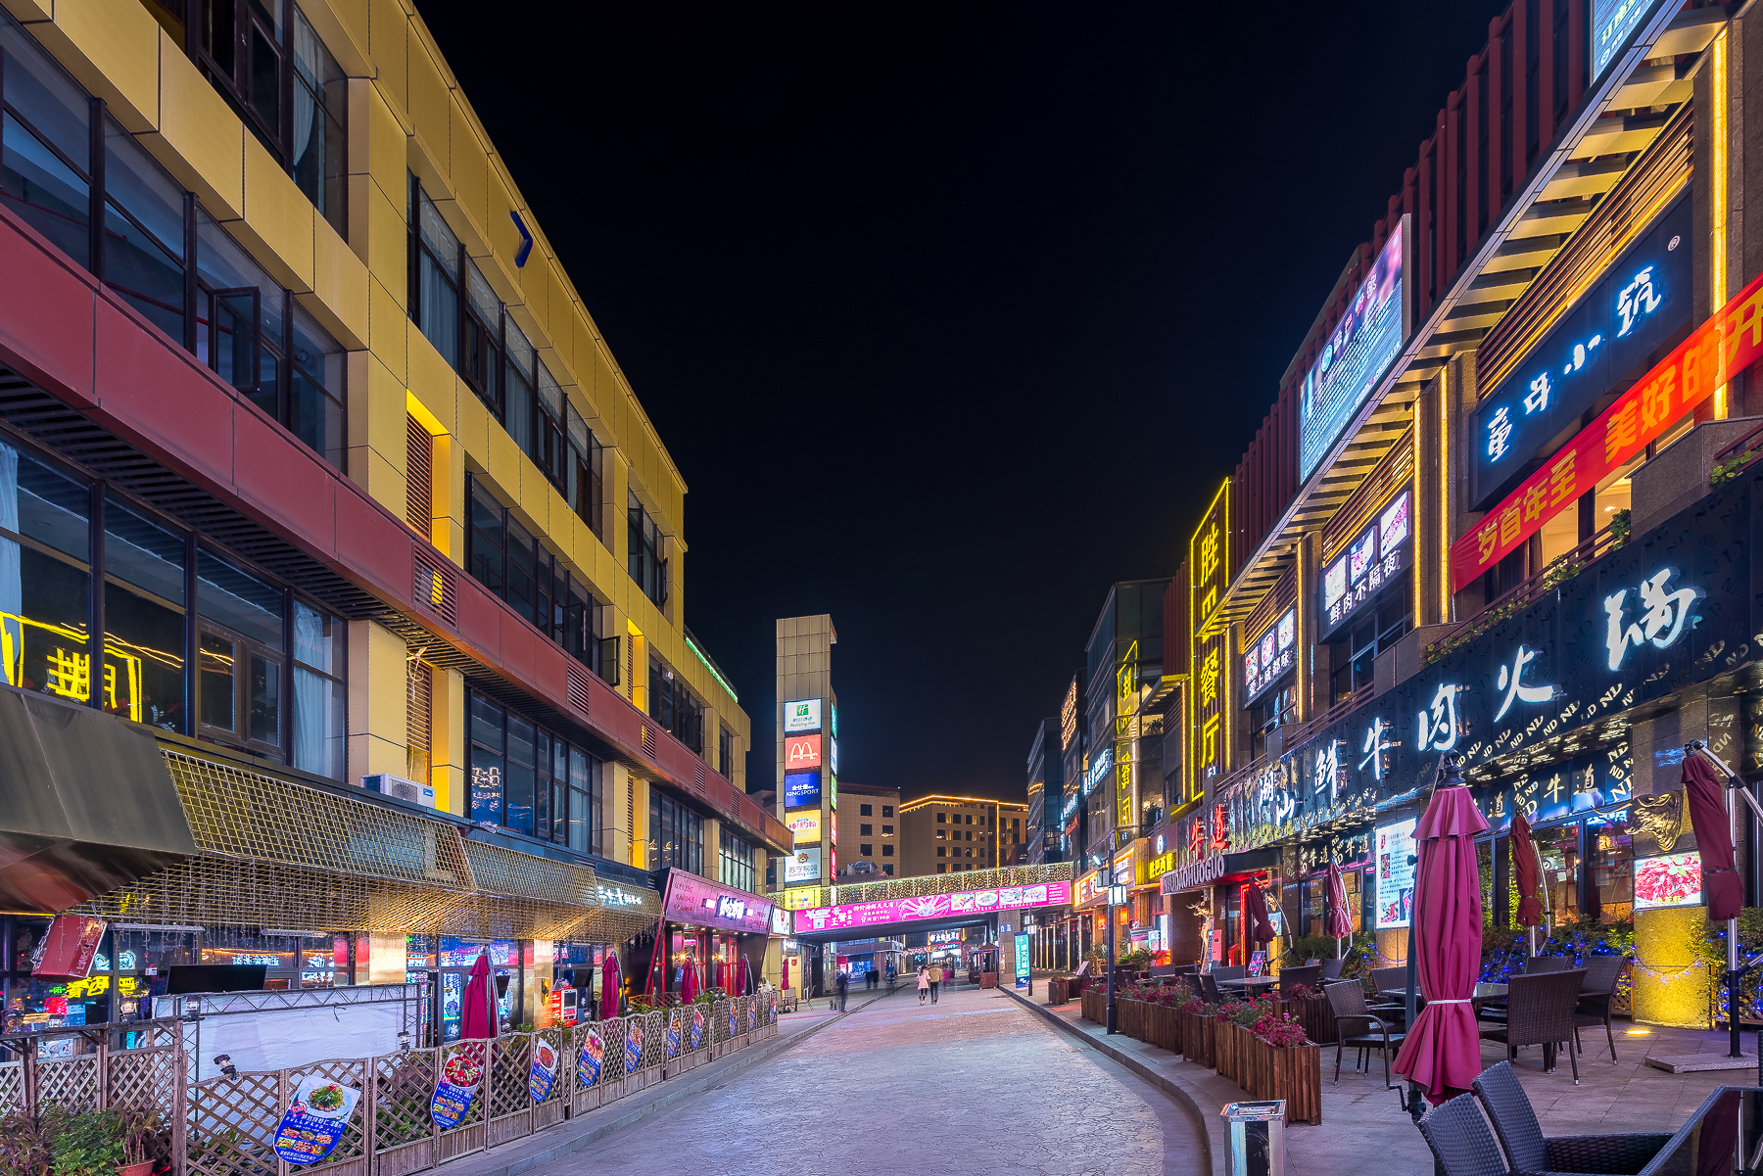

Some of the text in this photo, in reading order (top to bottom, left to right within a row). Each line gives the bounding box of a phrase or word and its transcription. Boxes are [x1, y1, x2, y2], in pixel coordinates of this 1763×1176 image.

[1477, 448, 1577, 566] 岁首年至
[1329, 549, 1399, 626] 鲜肉不隔夜
[1560, 700, 1580, 722] ND
[1543, 719, 1558, 736] ND
[1510, 733, 1524, 748] ND
[1607, 741, 1630, 763] ND
[1608, 764, 1625, 780] ND
[786, 788, 819, 797] KINGSPORT
[1524, 780, 1540, 796] ND
[1543, 763, 1599, 804] 牛道
[1189, 804, 1230, 861] 牛道
[1308, 845, 1329, 867] 牛道
[1345, 833, 1369, 858] 牛道
